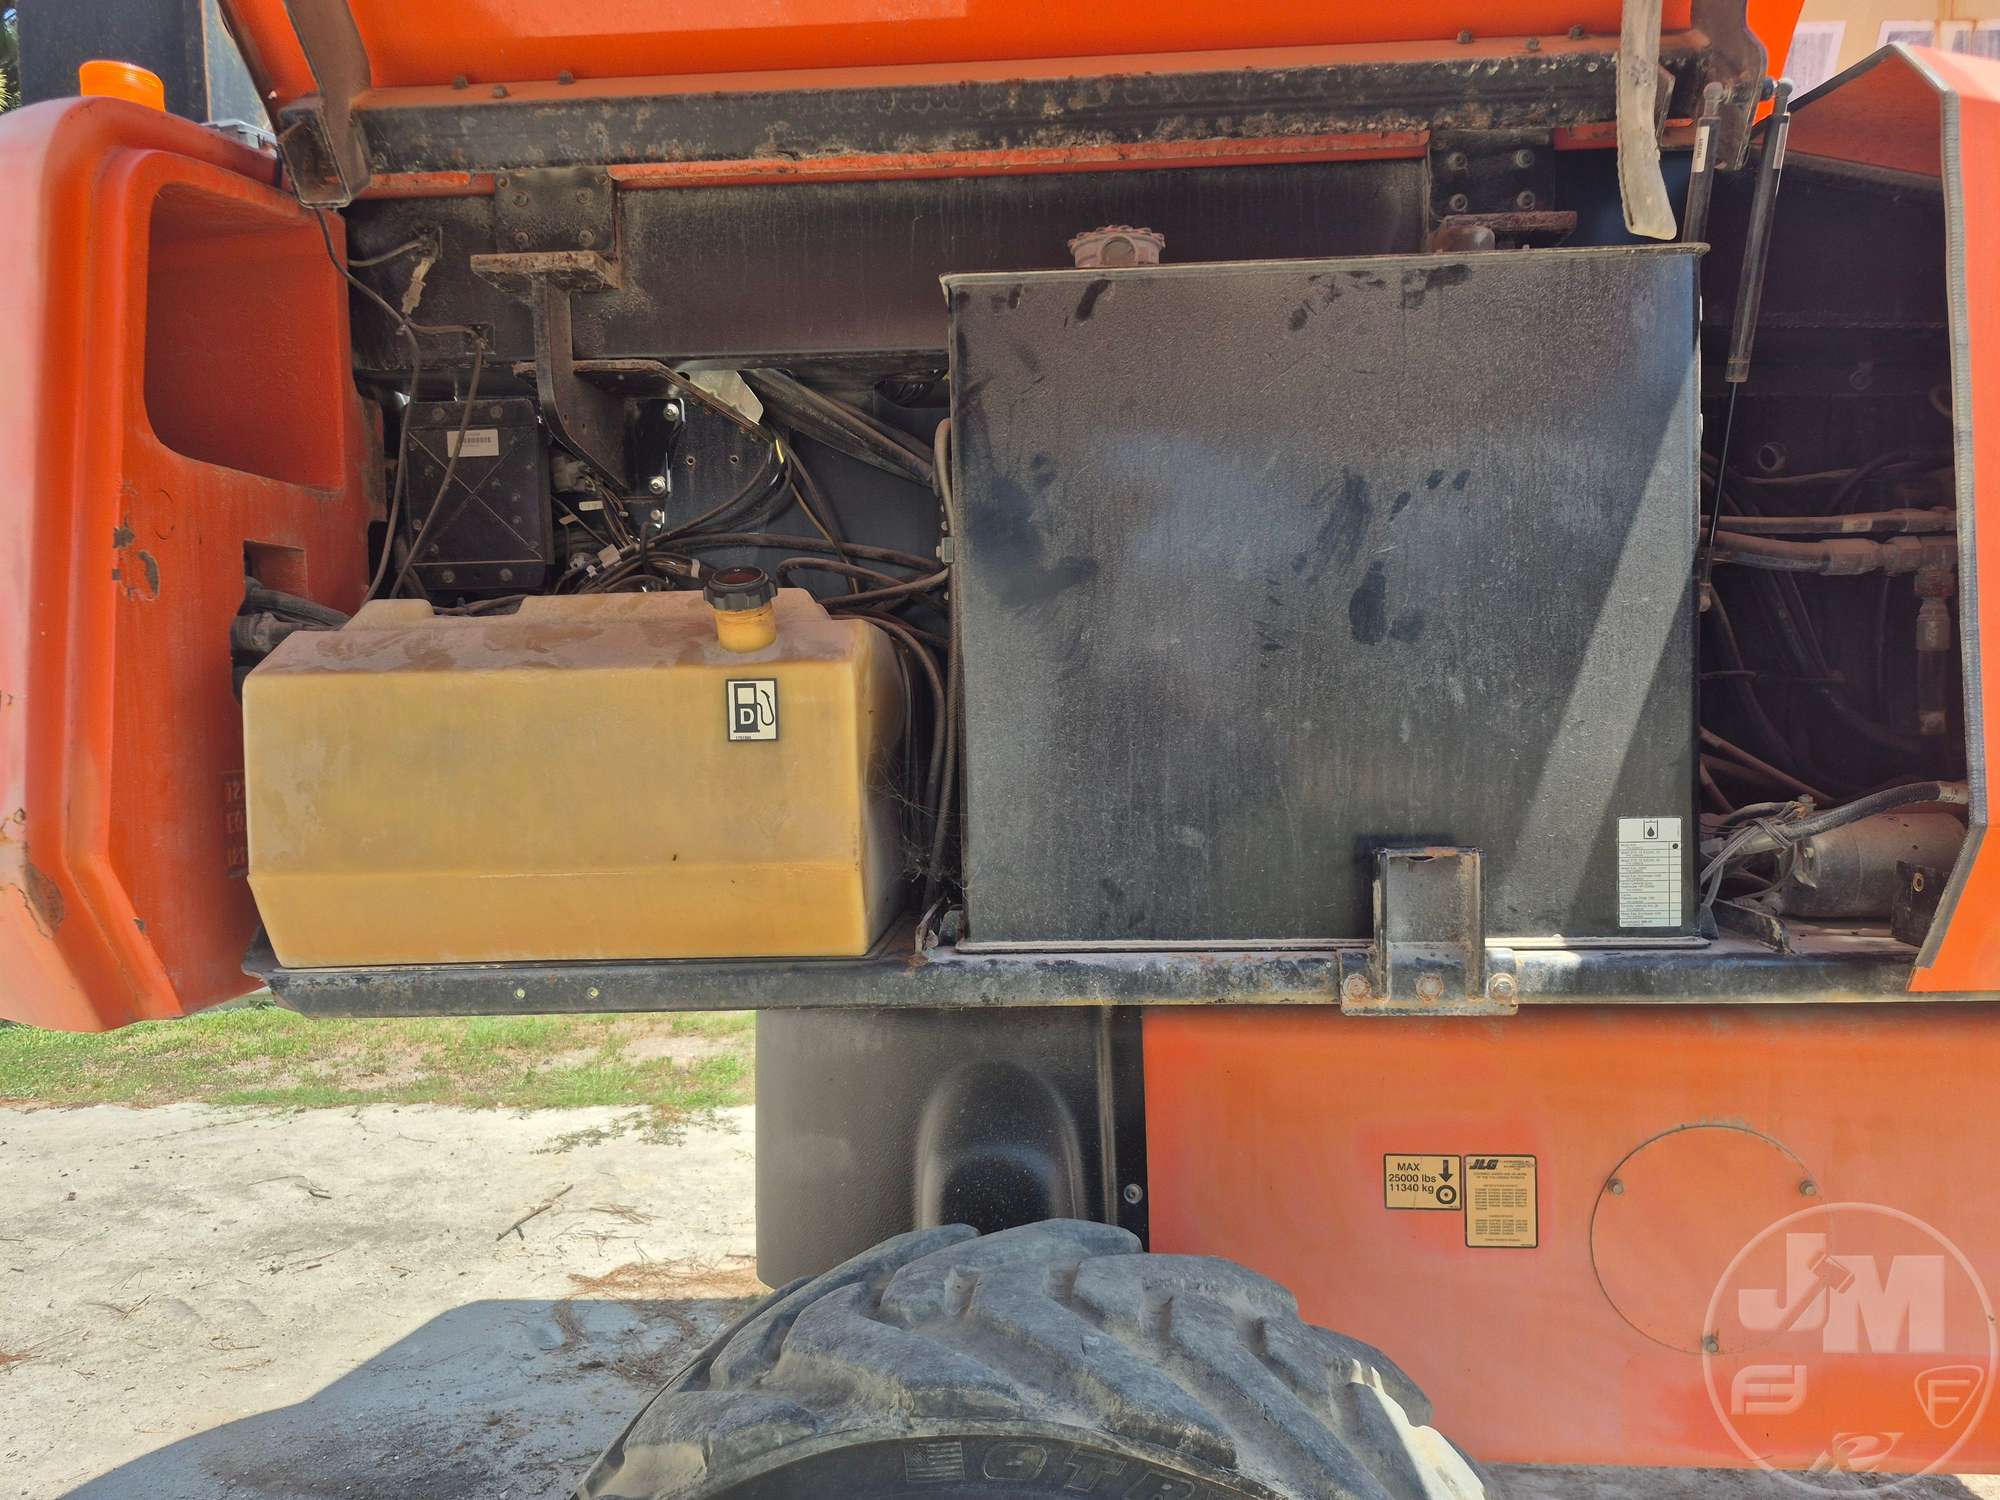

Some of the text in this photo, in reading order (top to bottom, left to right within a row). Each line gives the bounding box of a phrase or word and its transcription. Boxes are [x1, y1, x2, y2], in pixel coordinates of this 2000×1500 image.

[740, 708, 755, 725] D
[1397, 1163, 1420, 1171] MAX
[1469, 1159, 1499, 1170] JLG
[1389, 1174, 1437, 1183] 25000 lbs
[1389, 1183, 1435, 1194] 11340 kg
